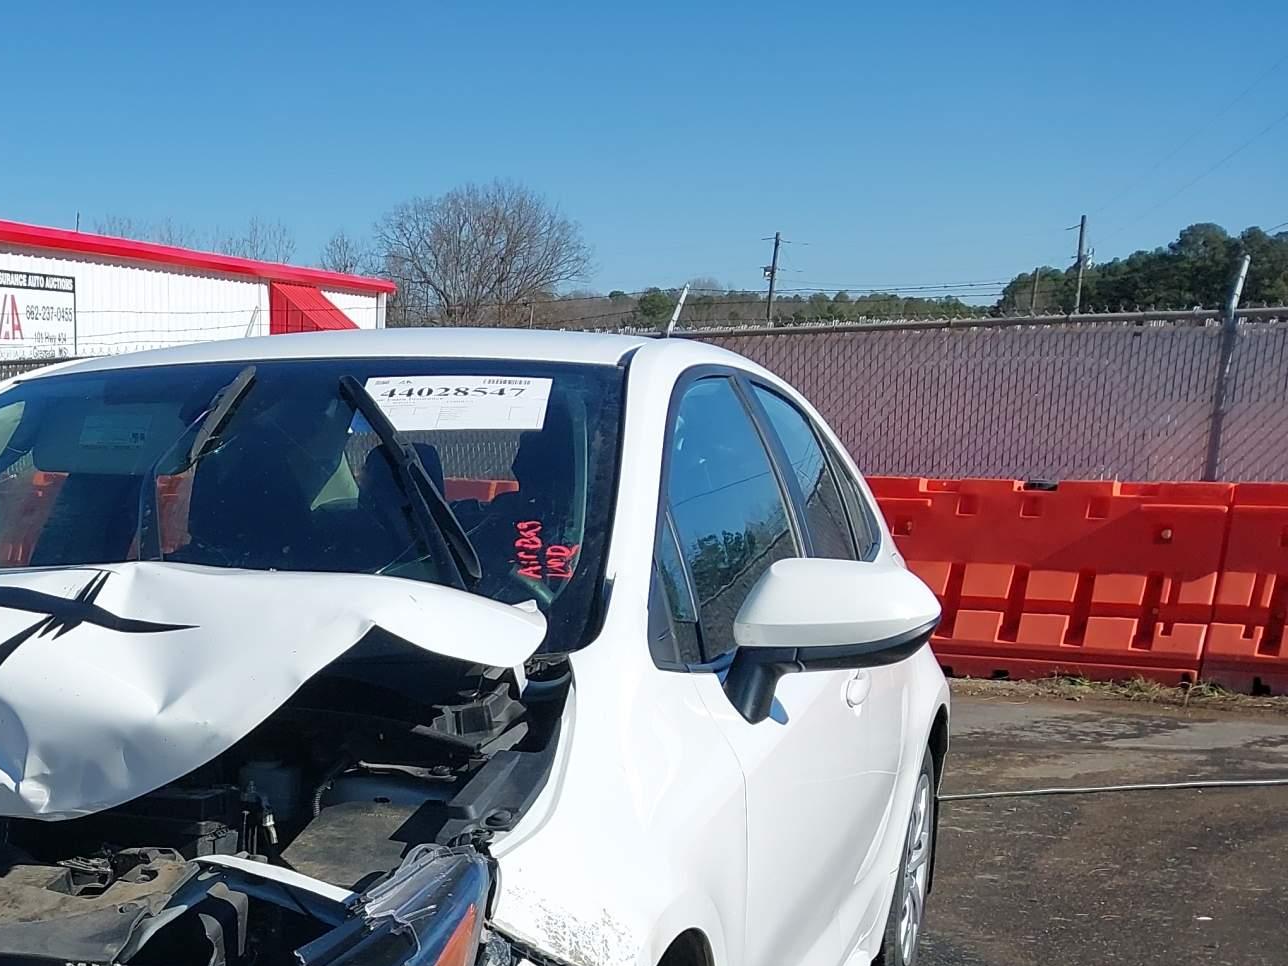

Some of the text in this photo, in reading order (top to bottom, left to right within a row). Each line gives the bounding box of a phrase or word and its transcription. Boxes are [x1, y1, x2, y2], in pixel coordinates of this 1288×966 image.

[27, 274, 45, 288] AUTO
[45, 276, 73, 291] AUCTIONS
[25, 304, 73, 322] 662-237-0455
[379, 386, 526, 398] 44028547
